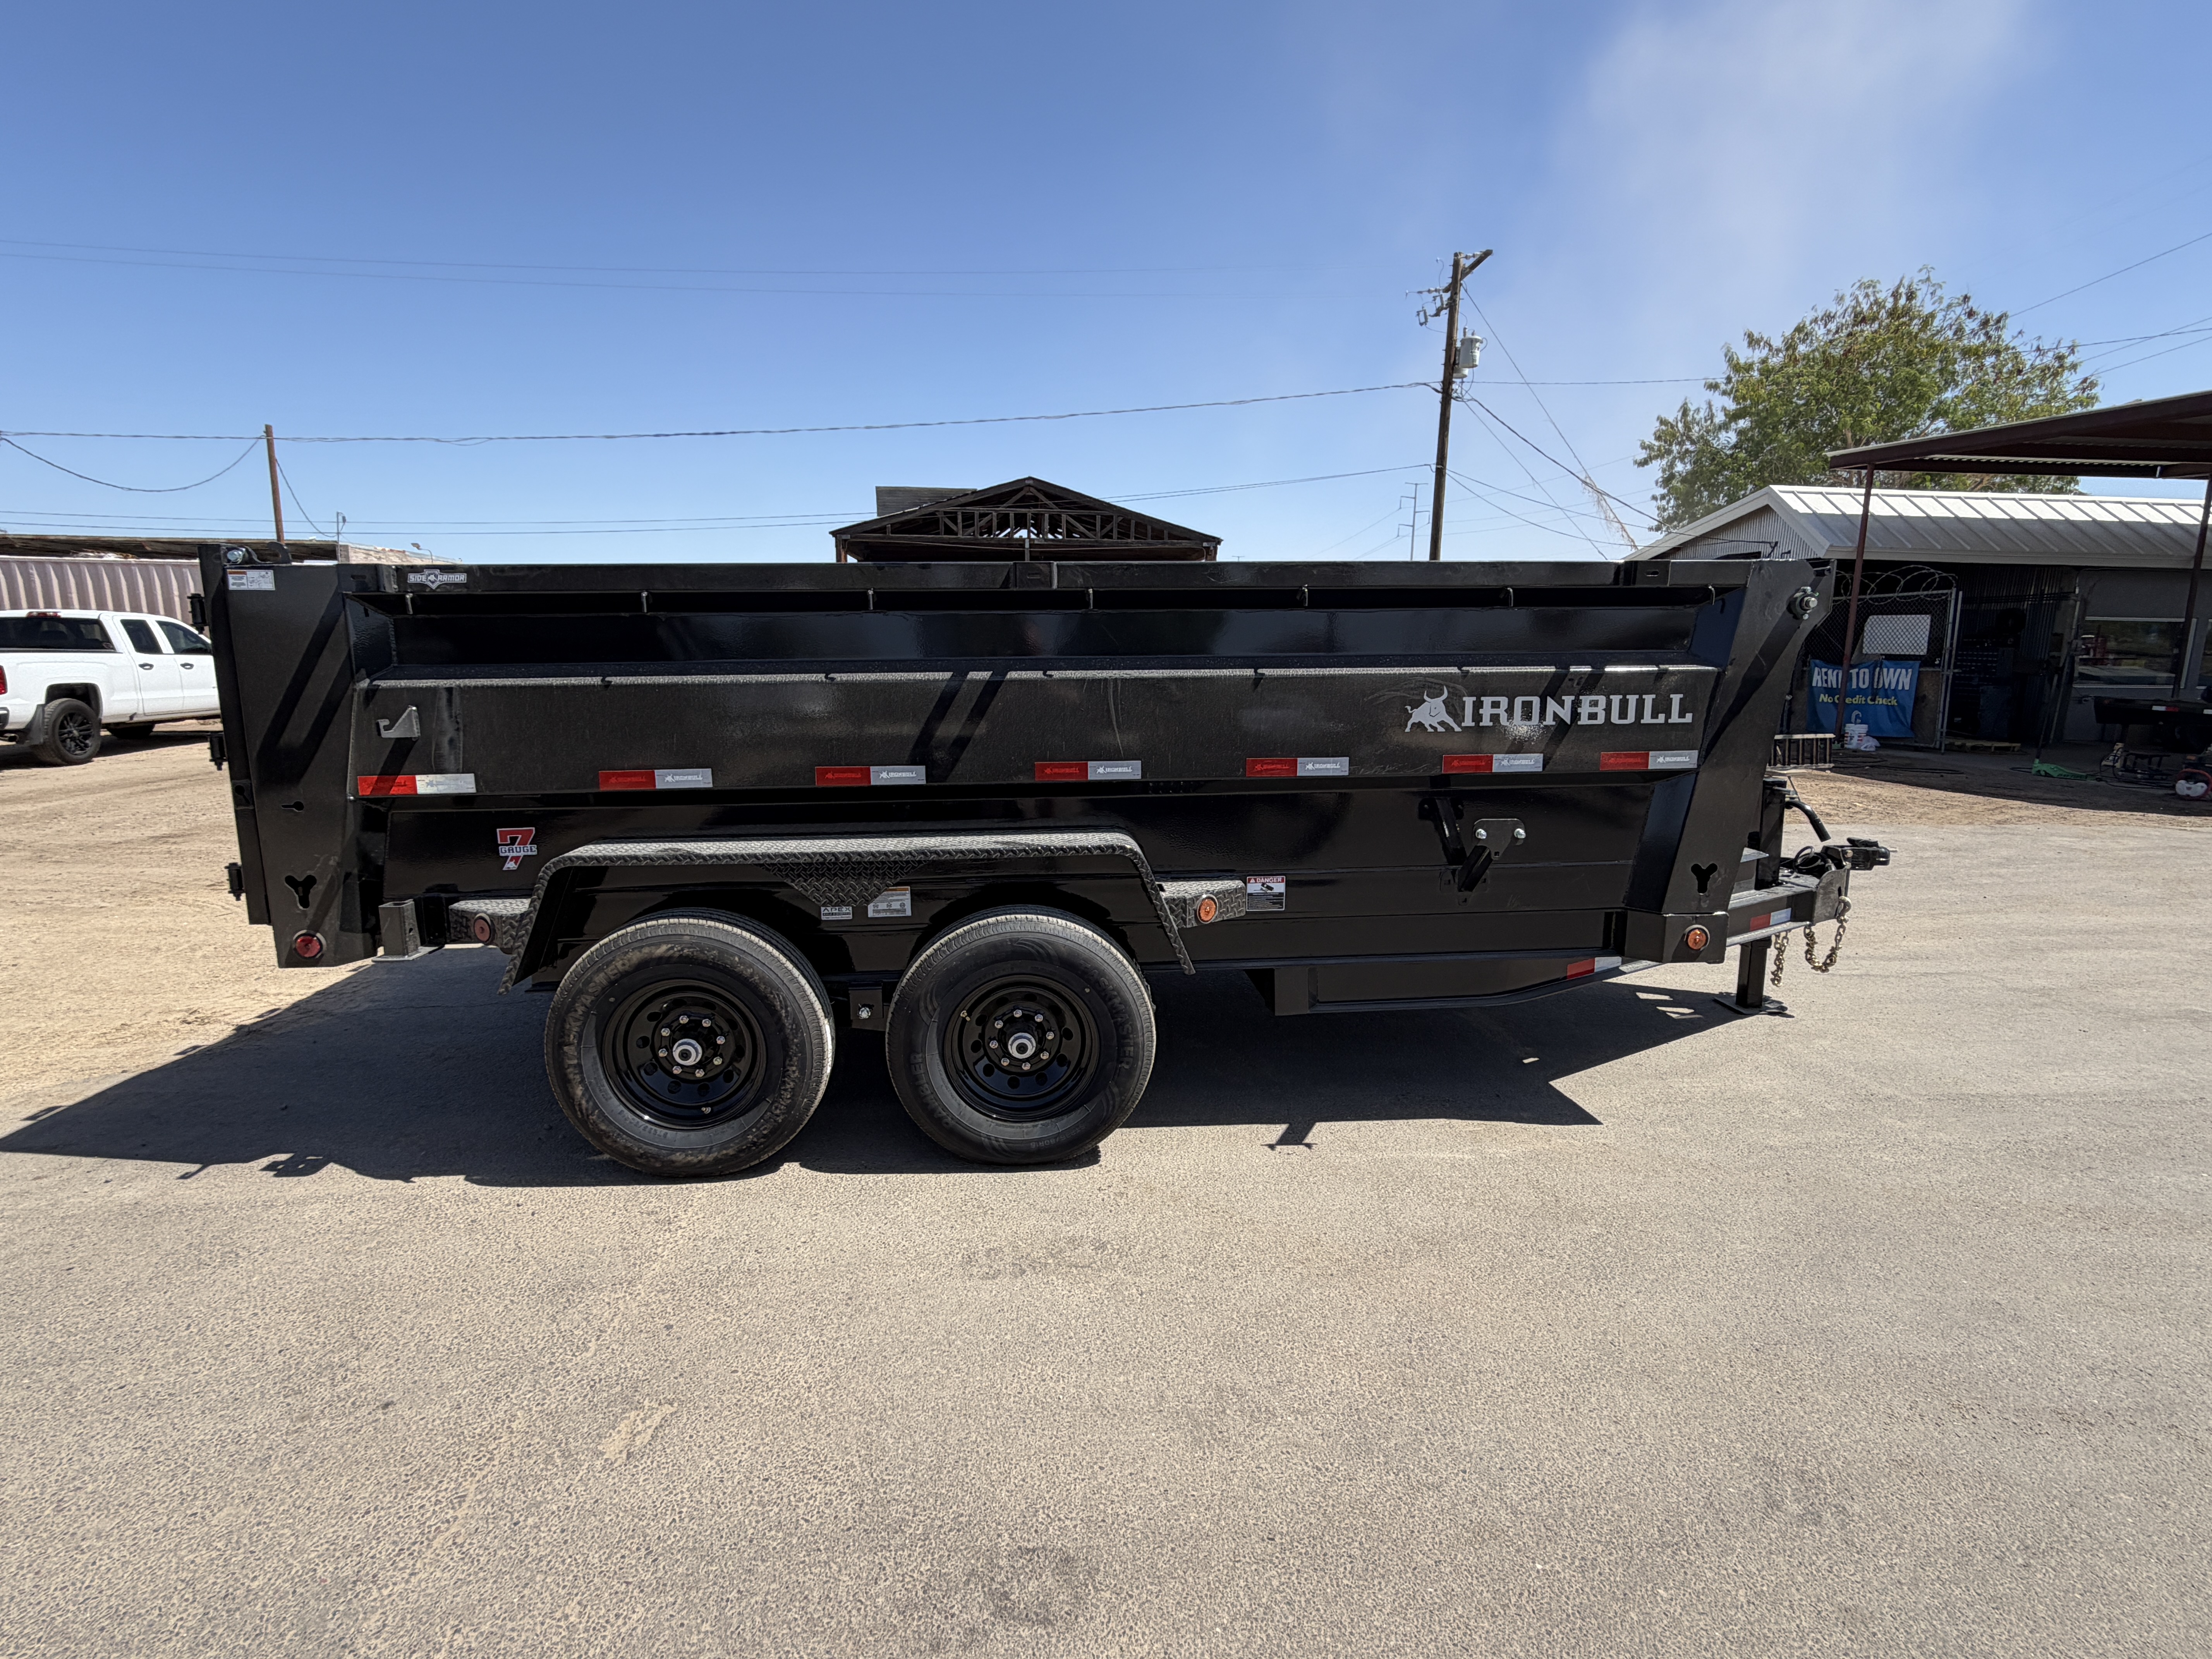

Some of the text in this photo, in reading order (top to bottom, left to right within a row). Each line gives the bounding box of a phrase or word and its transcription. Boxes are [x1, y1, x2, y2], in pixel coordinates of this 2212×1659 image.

[1819, 694, 1898, 706] No Cedit Check
[1850, 668, 1869, 689] TO
[1874, 667, 1912, 690] OWN
[1462, 694, 1693, 726] IRONBULL
[496, 827, 535, 870] 7
[563, 960, 630, 1068] TASKMASTER
[1079, 960, 1134, 1069] TASKMASTER
[910, 1053, 953, 1130] RAMBLER
